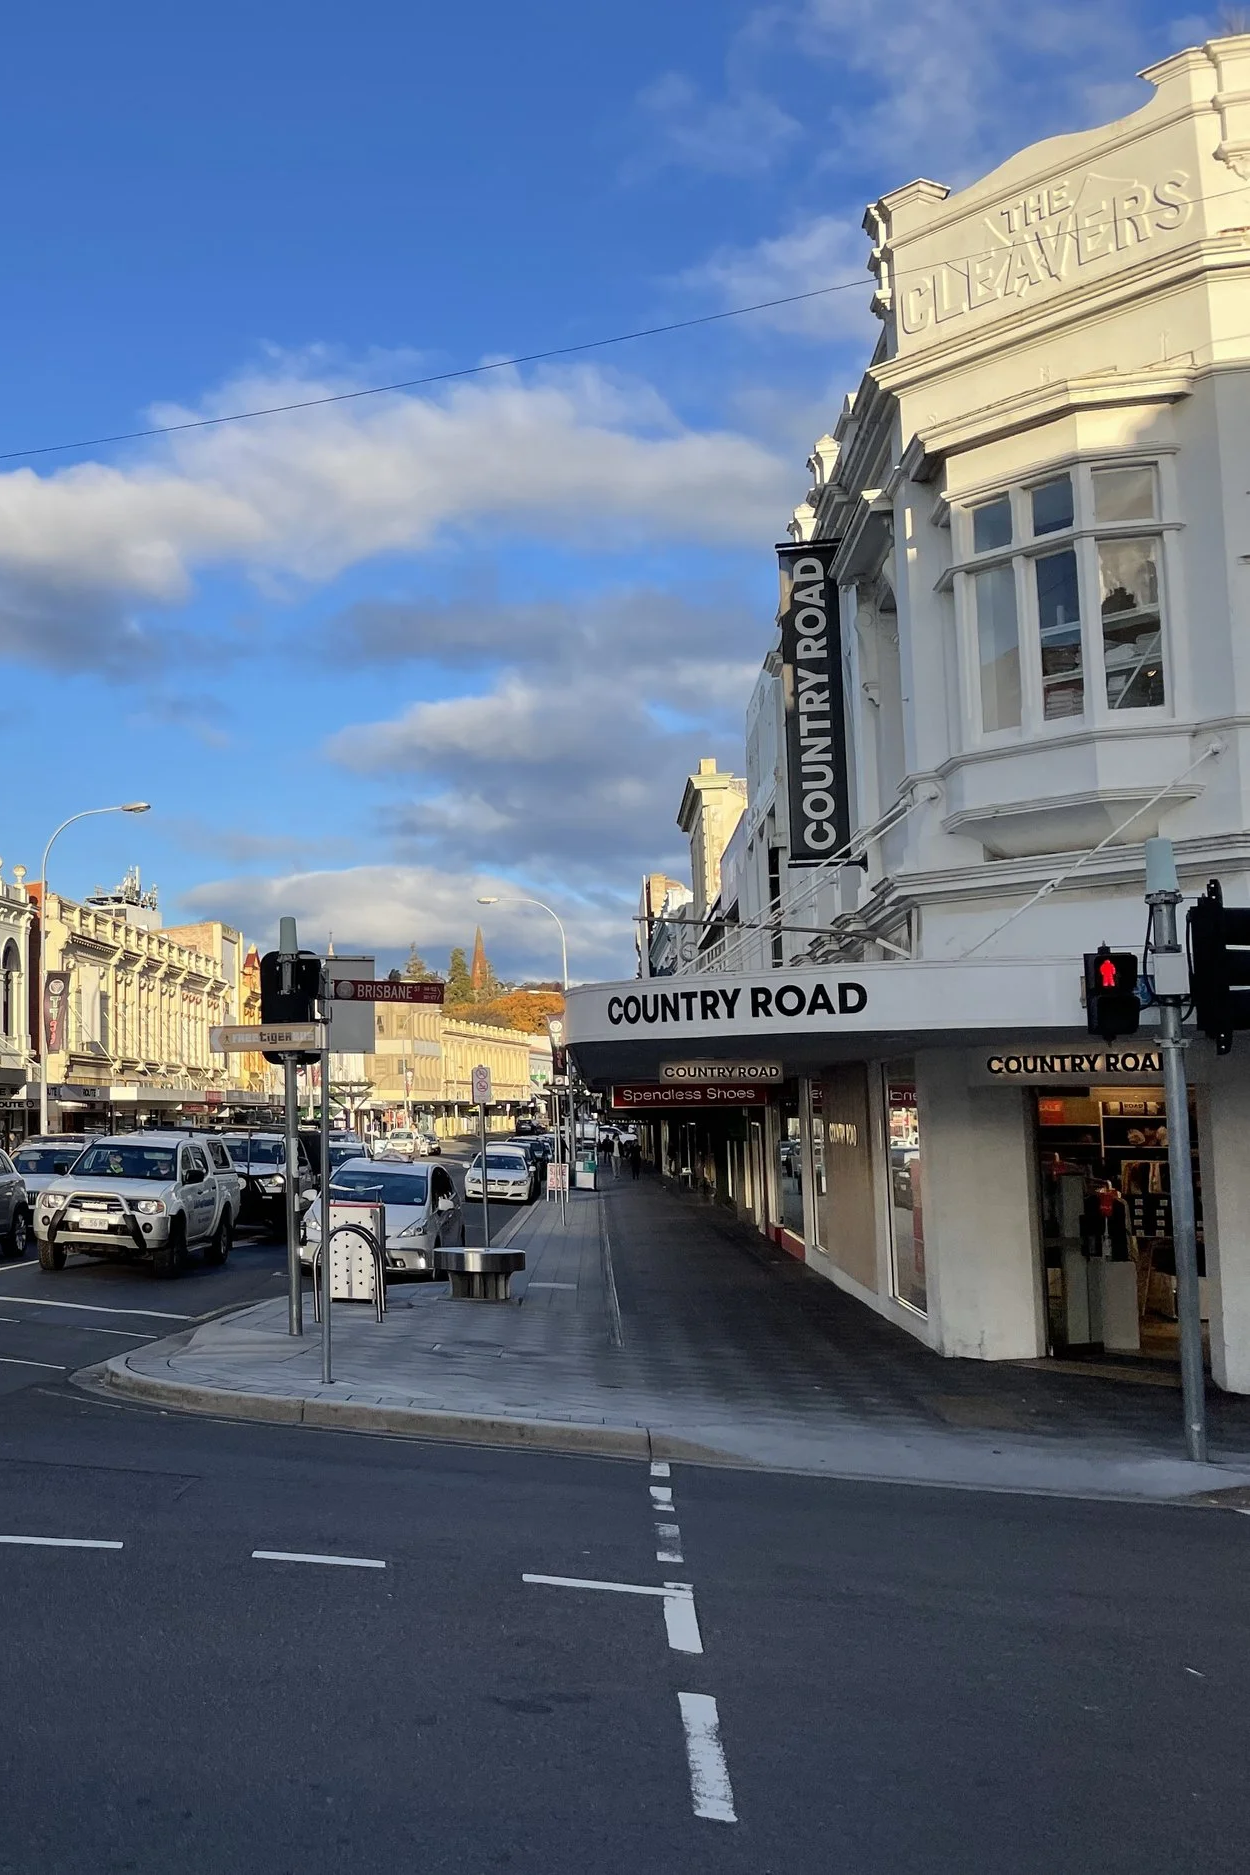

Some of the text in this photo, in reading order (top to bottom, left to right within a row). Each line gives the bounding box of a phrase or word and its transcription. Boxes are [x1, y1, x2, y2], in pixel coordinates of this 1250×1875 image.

[1001, 180, 1074, 234] THE
[900, 170, 1193, 335] CLEAVERS
[792, 557, 837, 850] COUNTRY ROAD
[357, 984, 414, 1000] BRISBANE
[607, 982, 868, 1025] COUNTRY ROAD
[664, 1066, 780, 1079] COUNTRY ROAD
[987, 1053, 1101, 1074] COUNTRY
[622, 1087, 756, 1103] Spendless Shoes
